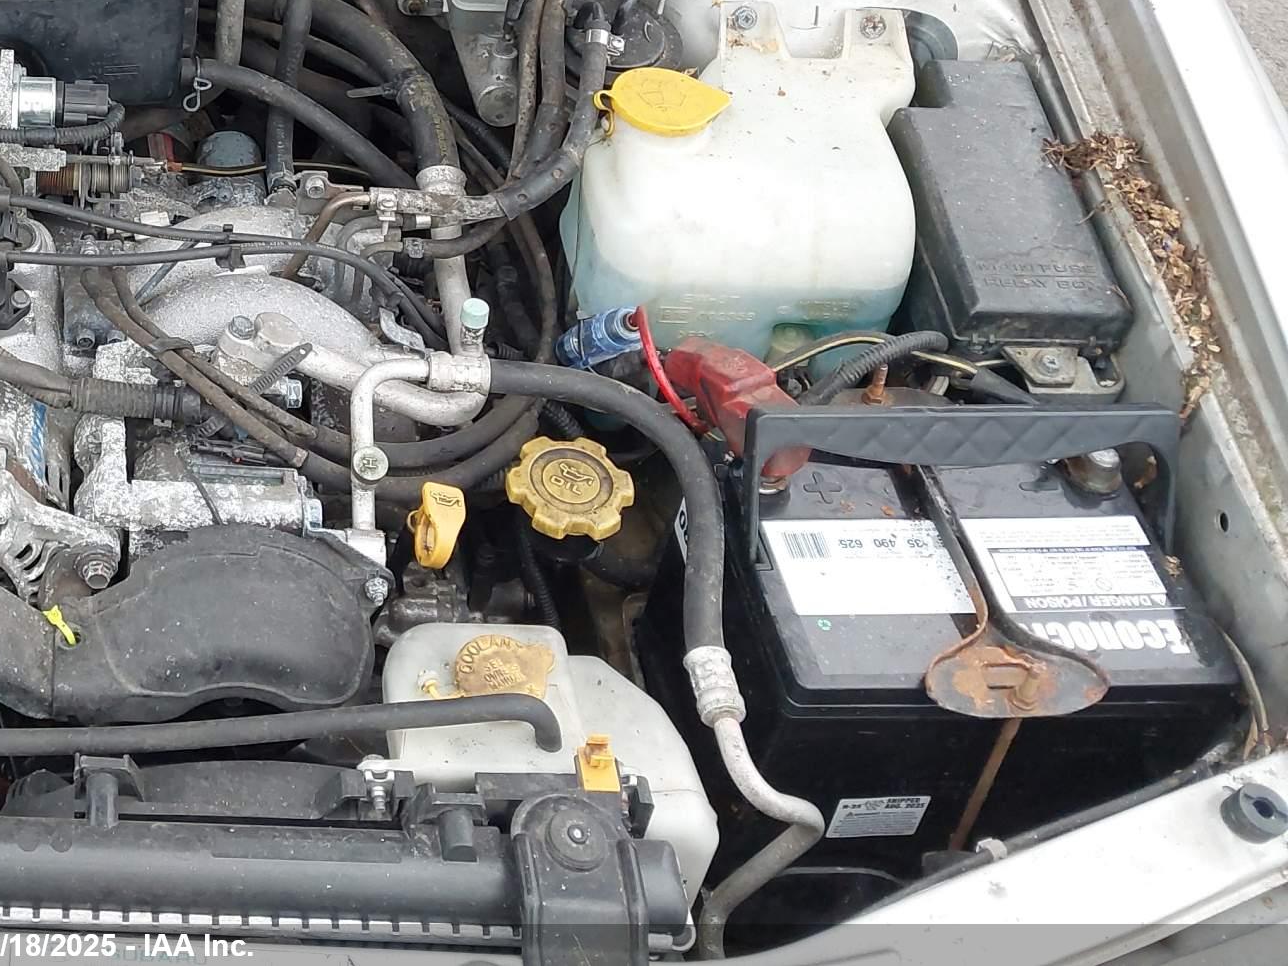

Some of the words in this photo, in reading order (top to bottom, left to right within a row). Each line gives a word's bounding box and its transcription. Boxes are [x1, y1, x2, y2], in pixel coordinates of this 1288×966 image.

[1038, 264, 1097, 274] FUSE
[550, 475, 583, 495] OIL
[838, 538, 864, 549] 625
[873, 538, 896, 549] 490
[1023, 596, 1083, 610] POISON
[1089, 594, 1153, 608] DANGER
